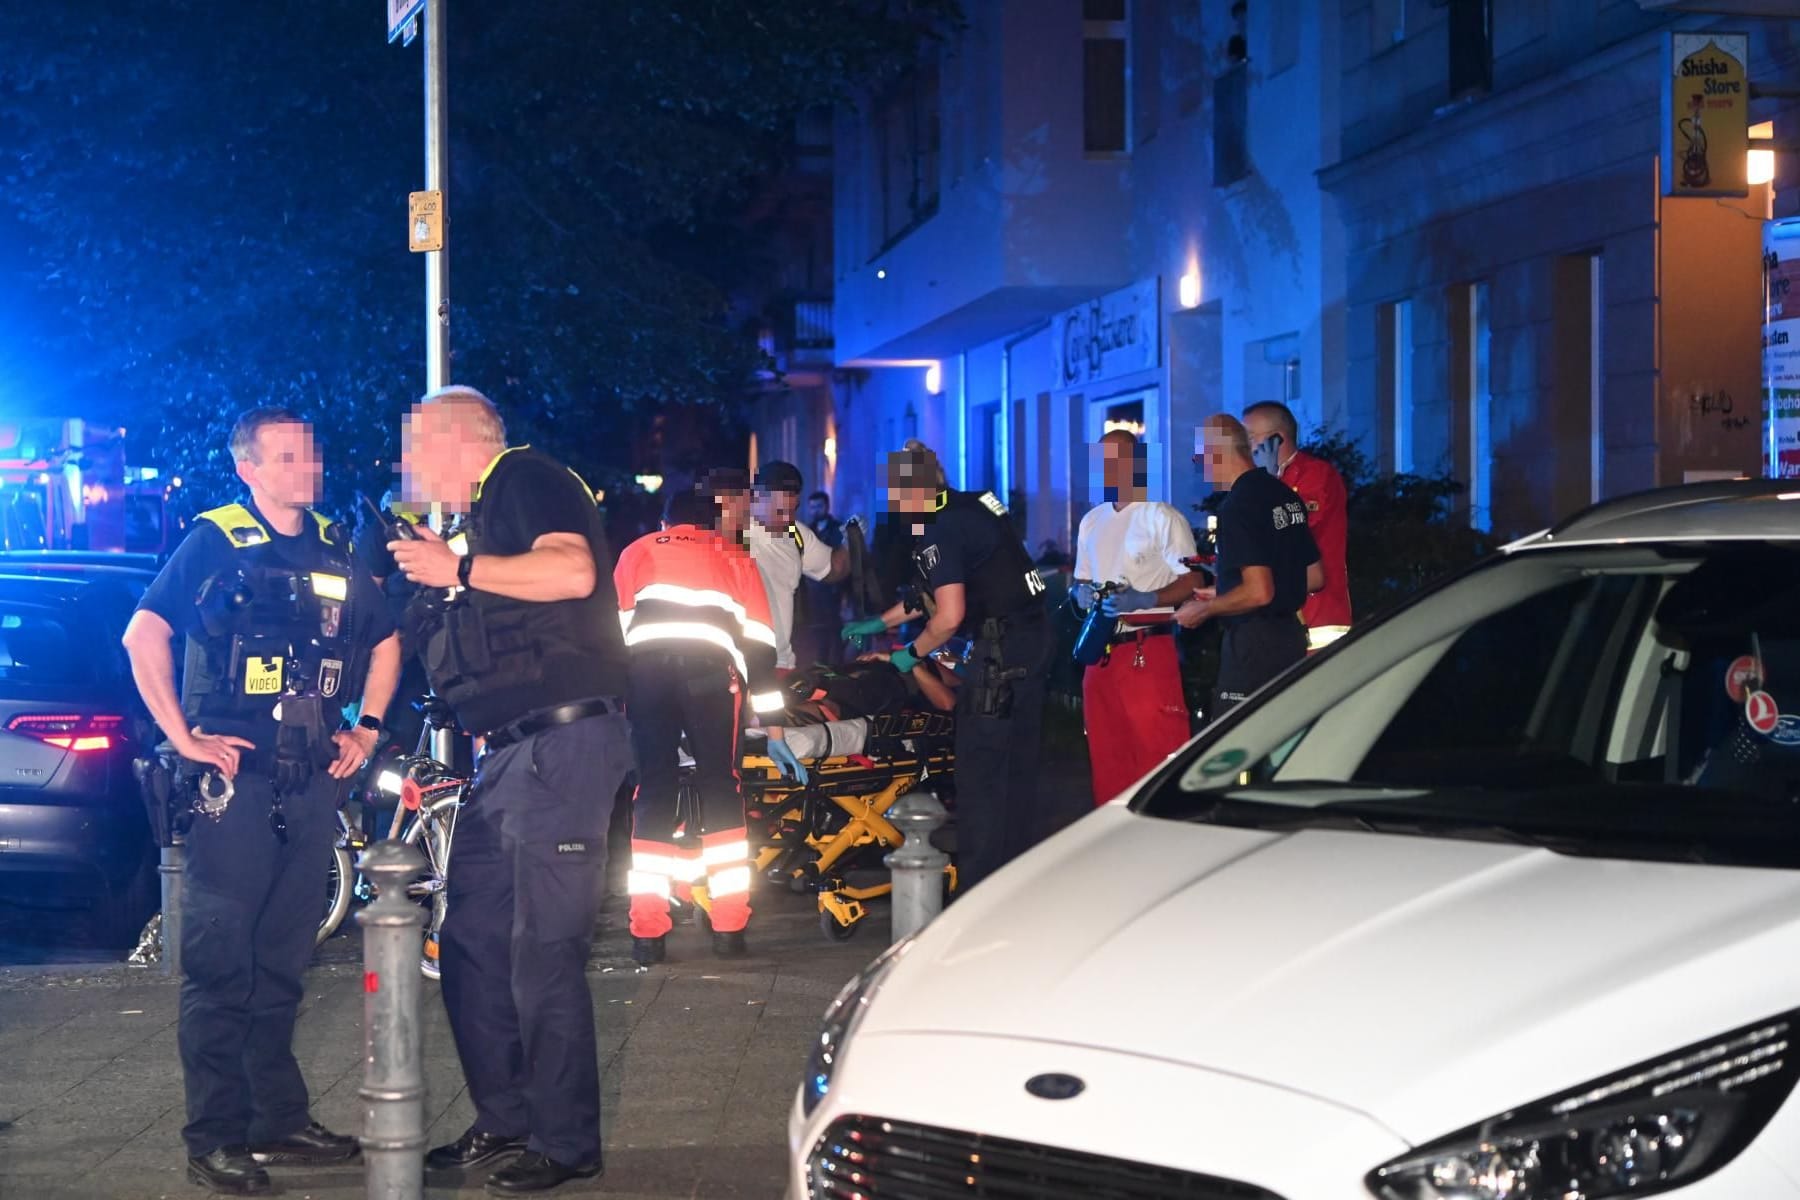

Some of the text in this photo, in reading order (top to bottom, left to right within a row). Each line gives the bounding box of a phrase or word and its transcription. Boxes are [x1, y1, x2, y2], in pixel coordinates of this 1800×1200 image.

[1681, 57, 1728, 77] Shisha
[1703, 77, 1741, 95] Store
[249, 677, 278, 690] VIDEO
